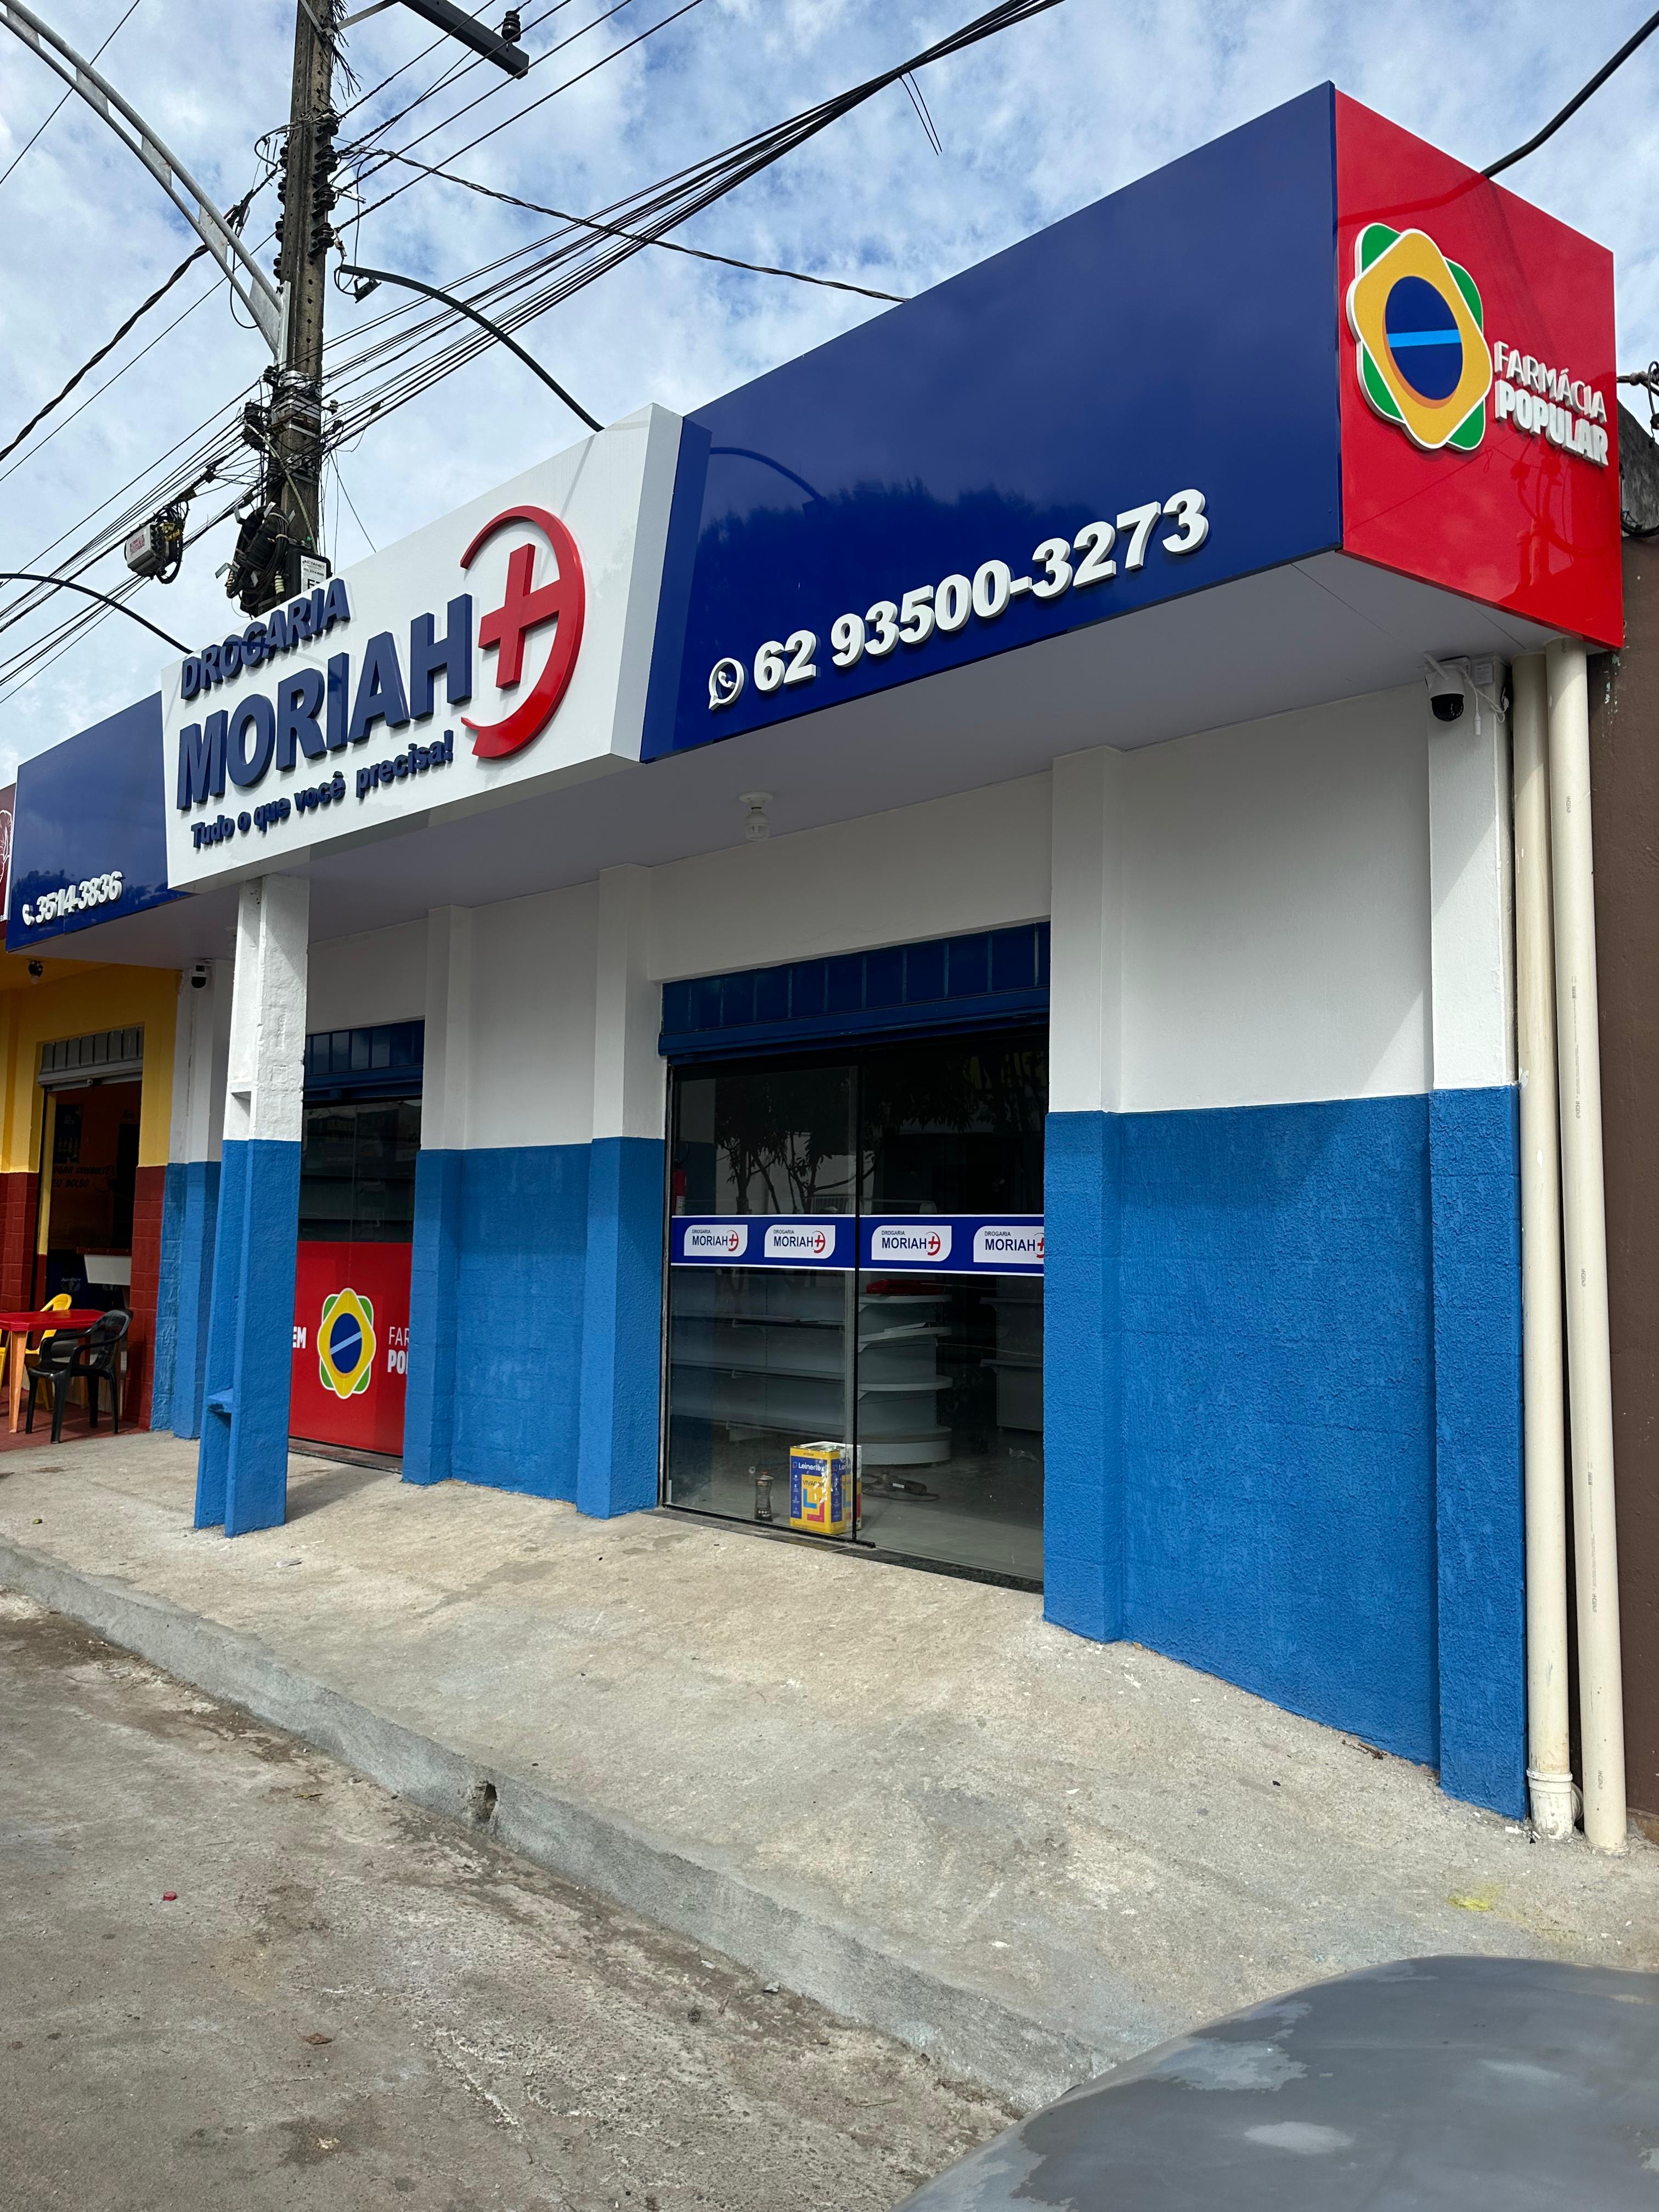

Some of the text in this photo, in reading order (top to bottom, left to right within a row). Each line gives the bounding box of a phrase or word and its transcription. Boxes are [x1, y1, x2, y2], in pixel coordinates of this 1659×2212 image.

[1494, 340, 1607, 424] FARMÁCIA
[1495, 380, 1609, 467] POPULAR
[754, 489, 1209, 691] 62 93500-3273
[181, 578, 351, 699] DROGARIA
[177, 593, 472, 810] MORIAH
[191, 730, 454, 849] Tudo o que você precisa!
[692, 1235, 728, 1246] MORIAH
[774, 1236, 813, 1247] MORIAH
[882, 1237, 927, 1249] MORIAH
[985, 1238, 1036, 1251] MORIAH
[798, 1462, 825, 1471] Leinertex
